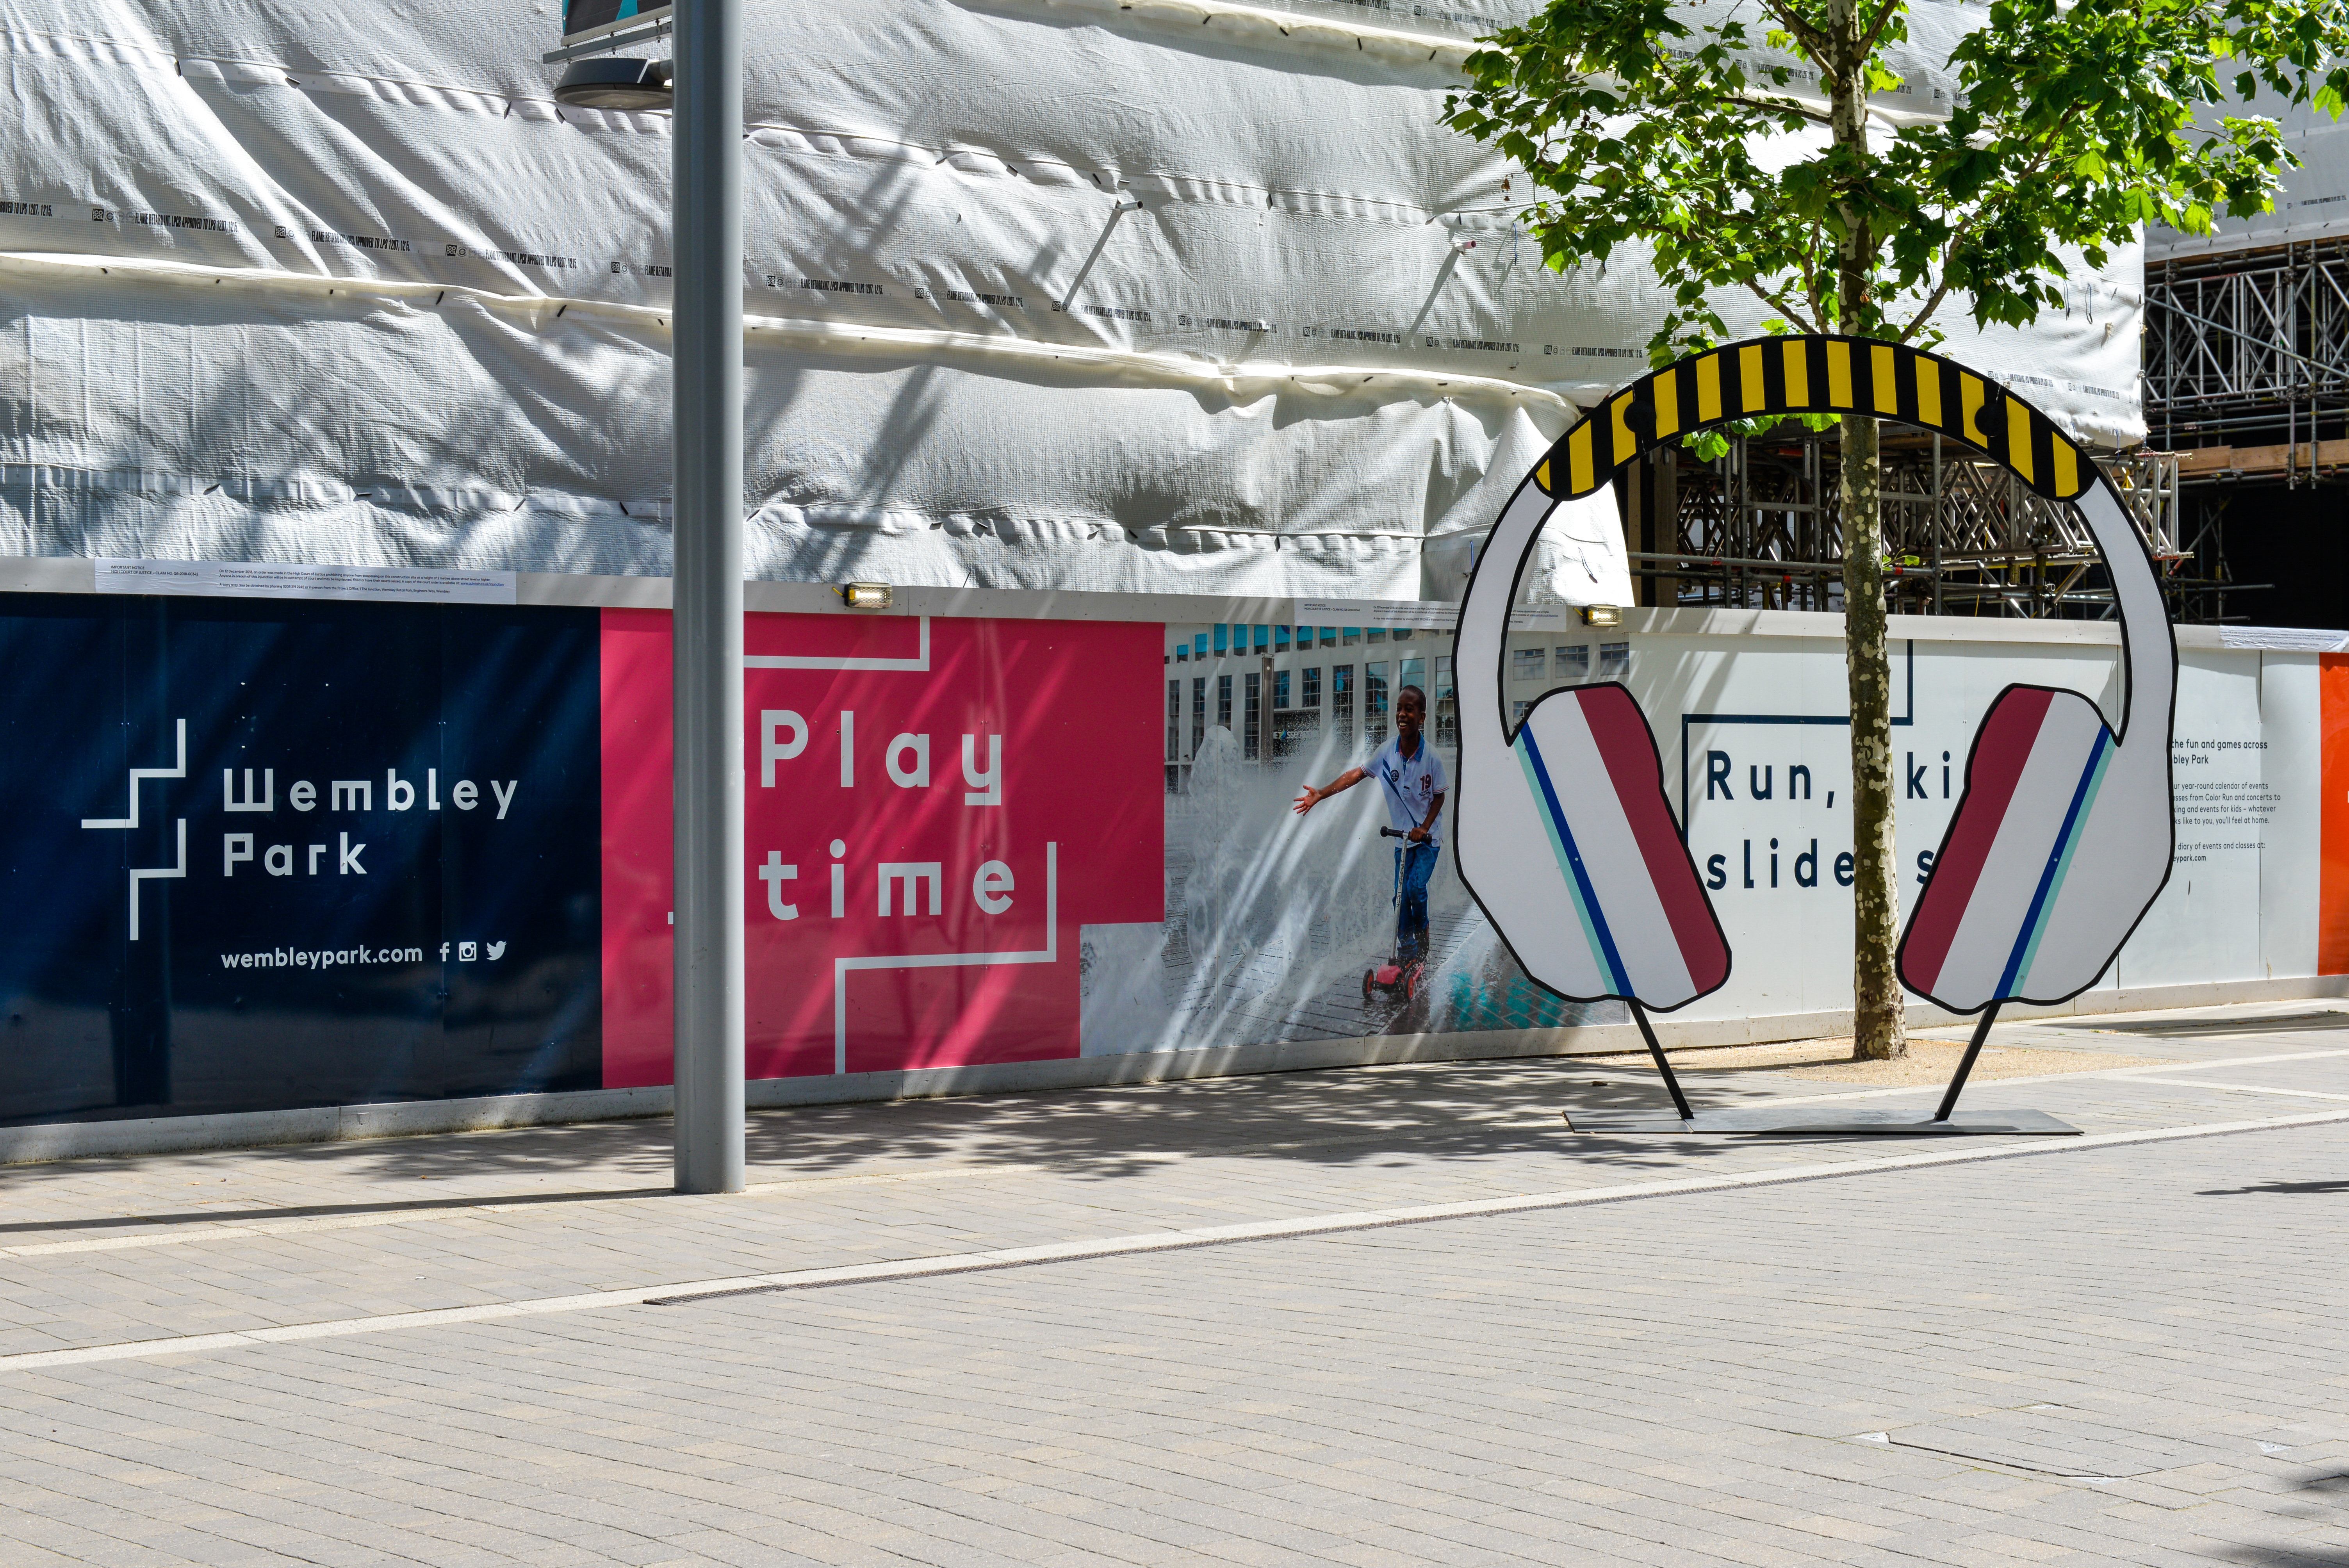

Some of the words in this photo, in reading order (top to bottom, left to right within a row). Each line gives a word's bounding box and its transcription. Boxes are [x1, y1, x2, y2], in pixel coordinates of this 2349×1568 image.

[0, 201, 13, 214] ROVED
[14, 202, 19, 214] TO
[20, 203, 28, 215] LPS
[29, 203, 39, 216] 1207,
[41, 204, 52, 217] 1215.
[135, 212, 148, 225] FLAME
[149, 214, 171, 227] RETARDANT,
[182, 217, 202, 229] APPROVED
[203, 219, 208, 230] TO
[217, 220, 228, 232] 1207,
[228, 221, 239, 233] 1215.
[312, 231, 324, 242] FLAME
[356, 236, 374, 248] APPROVED
[374, 237, 380, 249] TO
[389, 239, 399, 251] 1207,
[401, 240, 411, 251] 1215.
[527, 254, 544, 265] APPROVED
[545, 256, 549, 266] TO
[557, 257, 567, 268] 1207,
[568, 258, 577, 269] 1215.
[800, 278, 810, 289] FLAME
[810, 279, 830, 291] RETARDANT,
[839, 282, 854, 293] APPROVED
[855, 283, 859, 293] TO
[865, 283, 873, 295] 1207,
[875, 284, 883, 295] 1215.
[1572, 346, 1580, 356] FLAME
[1604, 348, 1617, 357] APPROVED
[1618, 349, 1621, 358] TO
[2187, 738, 2199, 748] fun
[2201, 739, 2215, 749] and
[2217, 741, 2241, 751] games
[761, 709, 1002, 806] Play
[2192, 754, 2209, 764] Park
[1420, 774, 1431, 791] 19
[1706, 750, 1836, 809] Run,
[2181, 782, 2214, 791] year-round
[224, 768, 518, 820] Wembley
[2205, 793, 2221, 801] Color
[2215, 816, 2230, 826] you'll
[224, 832, 367, 877] Park
[2178, 842, 2193, 851] diary
[758, 838, 1015, 920] time
[221, 943, 423, 970] wembleypark.com
